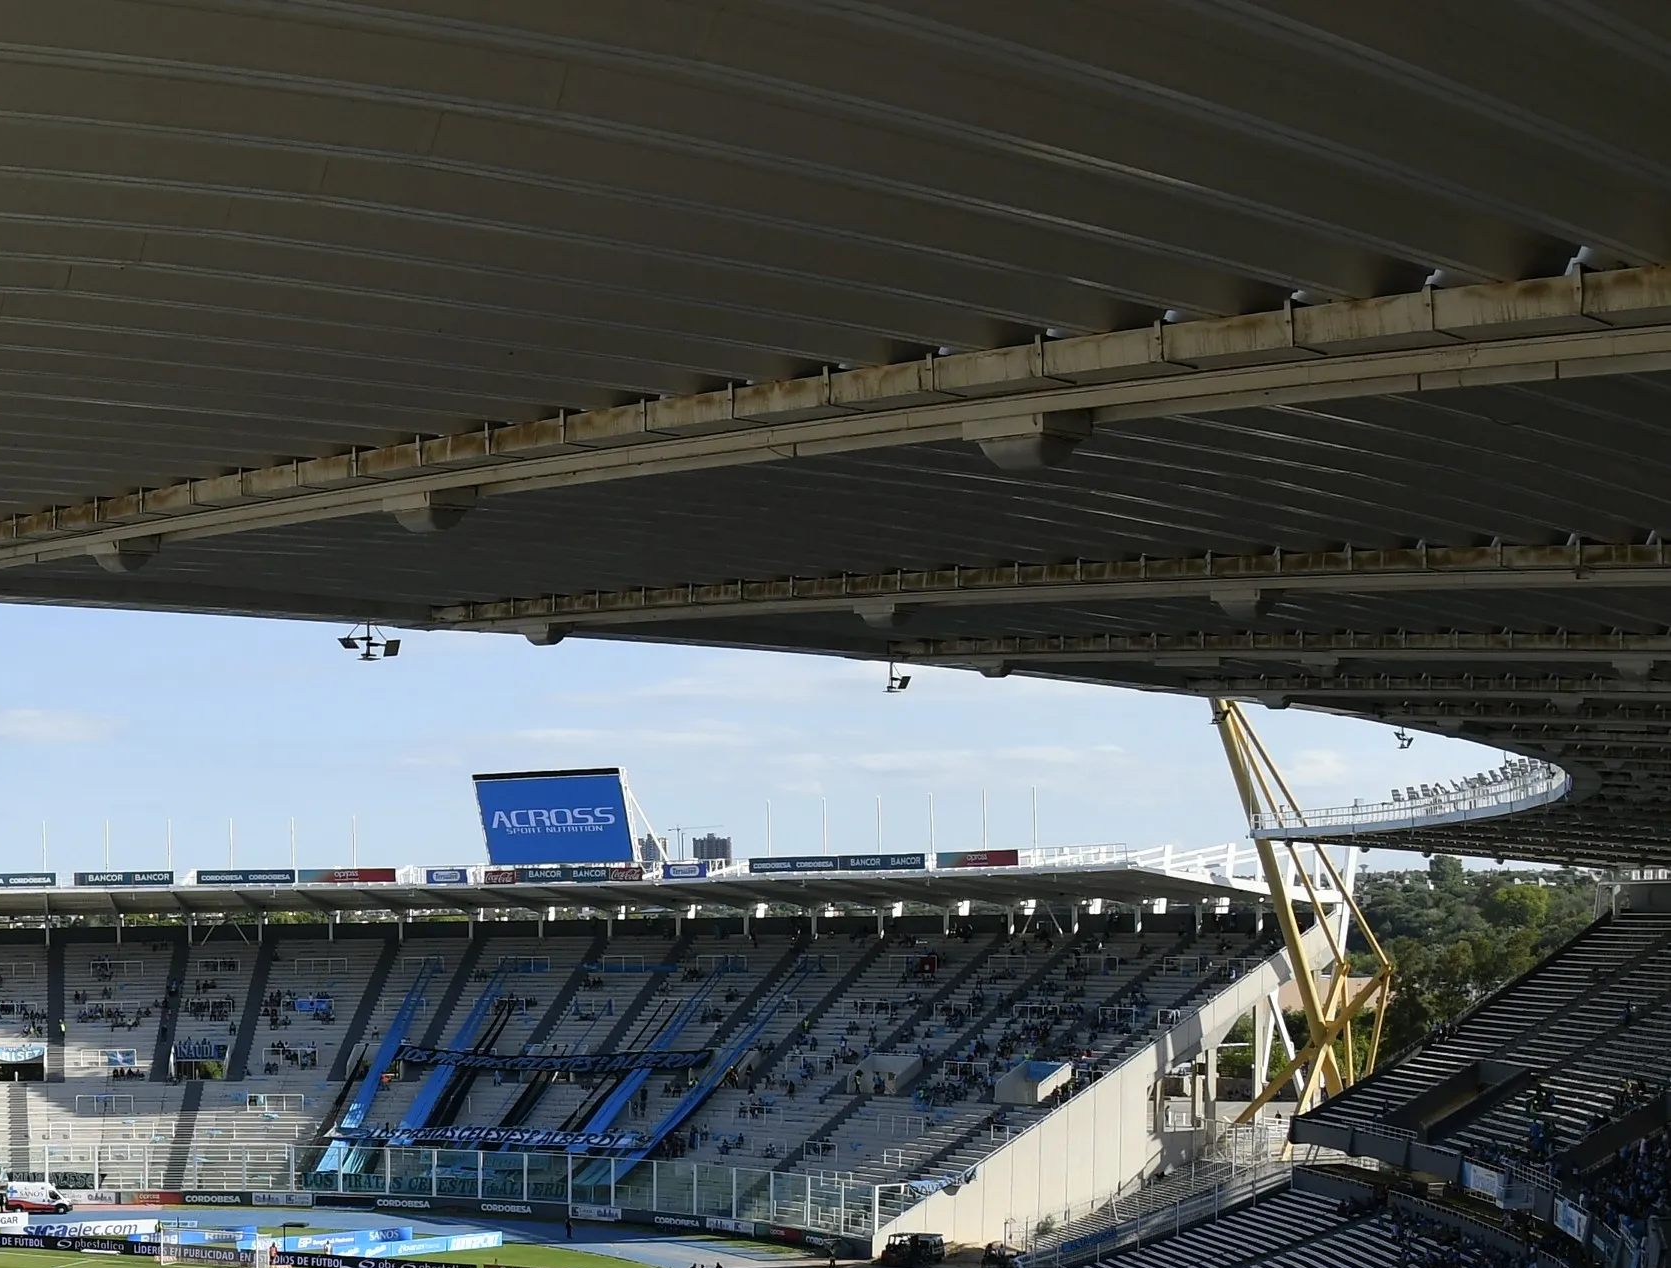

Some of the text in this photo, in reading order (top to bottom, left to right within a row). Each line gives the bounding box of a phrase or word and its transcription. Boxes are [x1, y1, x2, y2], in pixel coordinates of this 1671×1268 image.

[491, 807, 616, 829] ACROSS
[505, 825, 603, 835] SPORT NUTRITION
[849, 858, 881, 867] BANCOR
[890, 856, 921, 866] BANCOR
[87, 873, 123, 882] BANCOR
[134, 872, 170, 881] BANCOR
[527, 870, 562, 878] BANCOR
[572, 869, 607, 877] BANCOR
[185, 1195, 241, 1204] CORDOBESA
[376, 1199, 430, 1209] CORDOBESA
[481, 1203, 532, 1214] CORDOBESA
[654, 1216, 700, 1227] CORDOBESA
[23, 1222, 138, 1238] sicaelec.com
[369, 1229, 399, 1240] SANOS
[2, 1236, 13, 1246] DE
[14, 1235, 45, 1248] FÚTBOL
[183, 1248, 235, 1261] PUBLICIDAD
[239, 1250, 252, 1262] EN
[297, 1255, 309, 1266] DE
[311, 1254, 344, 1268] FÚTBOL
